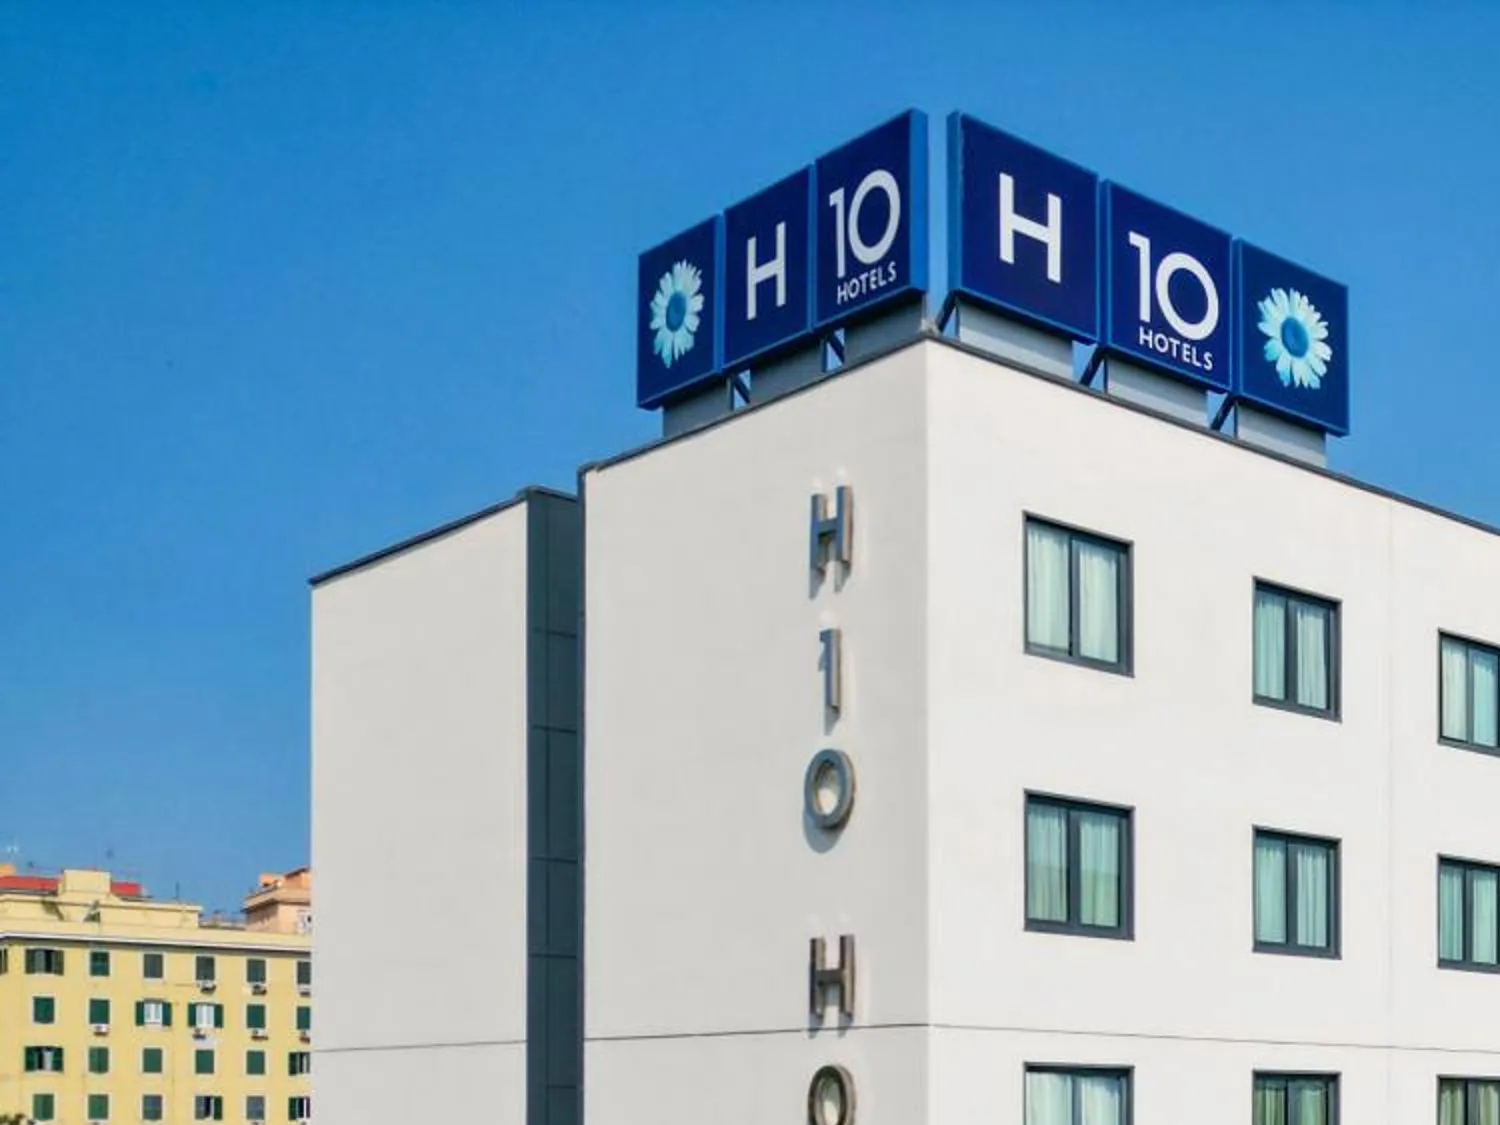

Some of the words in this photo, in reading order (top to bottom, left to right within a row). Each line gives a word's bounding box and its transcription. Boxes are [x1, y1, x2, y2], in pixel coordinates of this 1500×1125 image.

[829, 168, 900, 279] 10
[837, 260, 897, 305] HOTELS
[1128, 230, 1219, 341] 10
[1139, 326, 1213, 371] HOTELS
